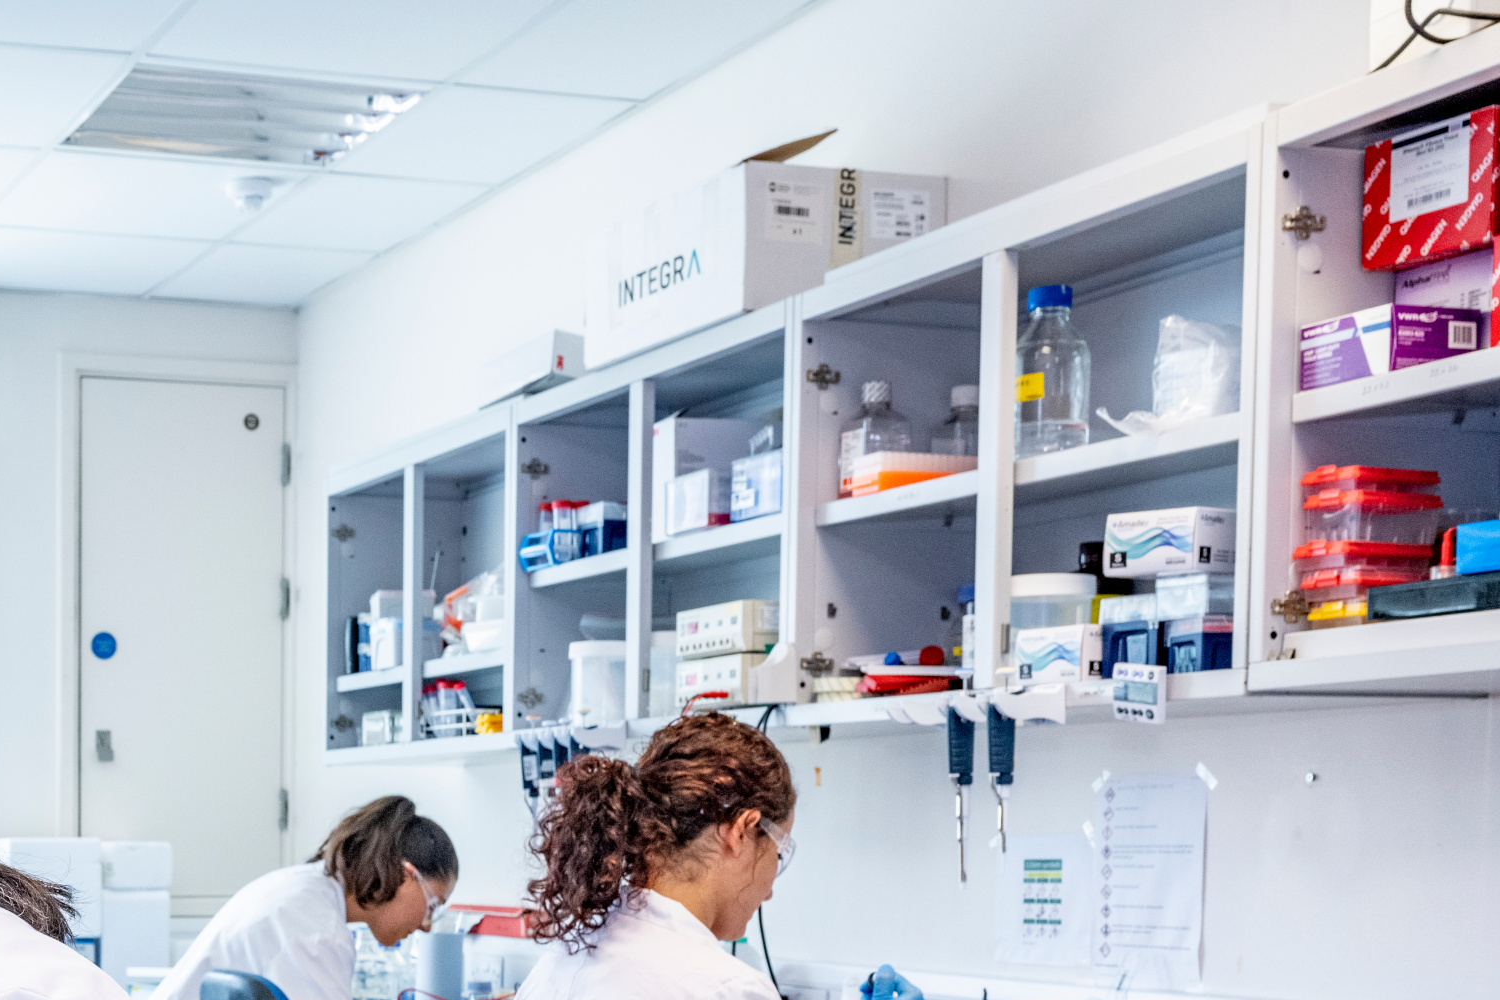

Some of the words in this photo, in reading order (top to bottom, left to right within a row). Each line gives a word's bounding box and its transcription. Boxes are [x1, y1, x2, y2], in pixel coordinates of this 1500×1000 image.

[837, 167, 856, 246] INTEGR
[1419, 218, 1448, 257] QIAGEN
[618, 248, 702, 309] INTEGRA
